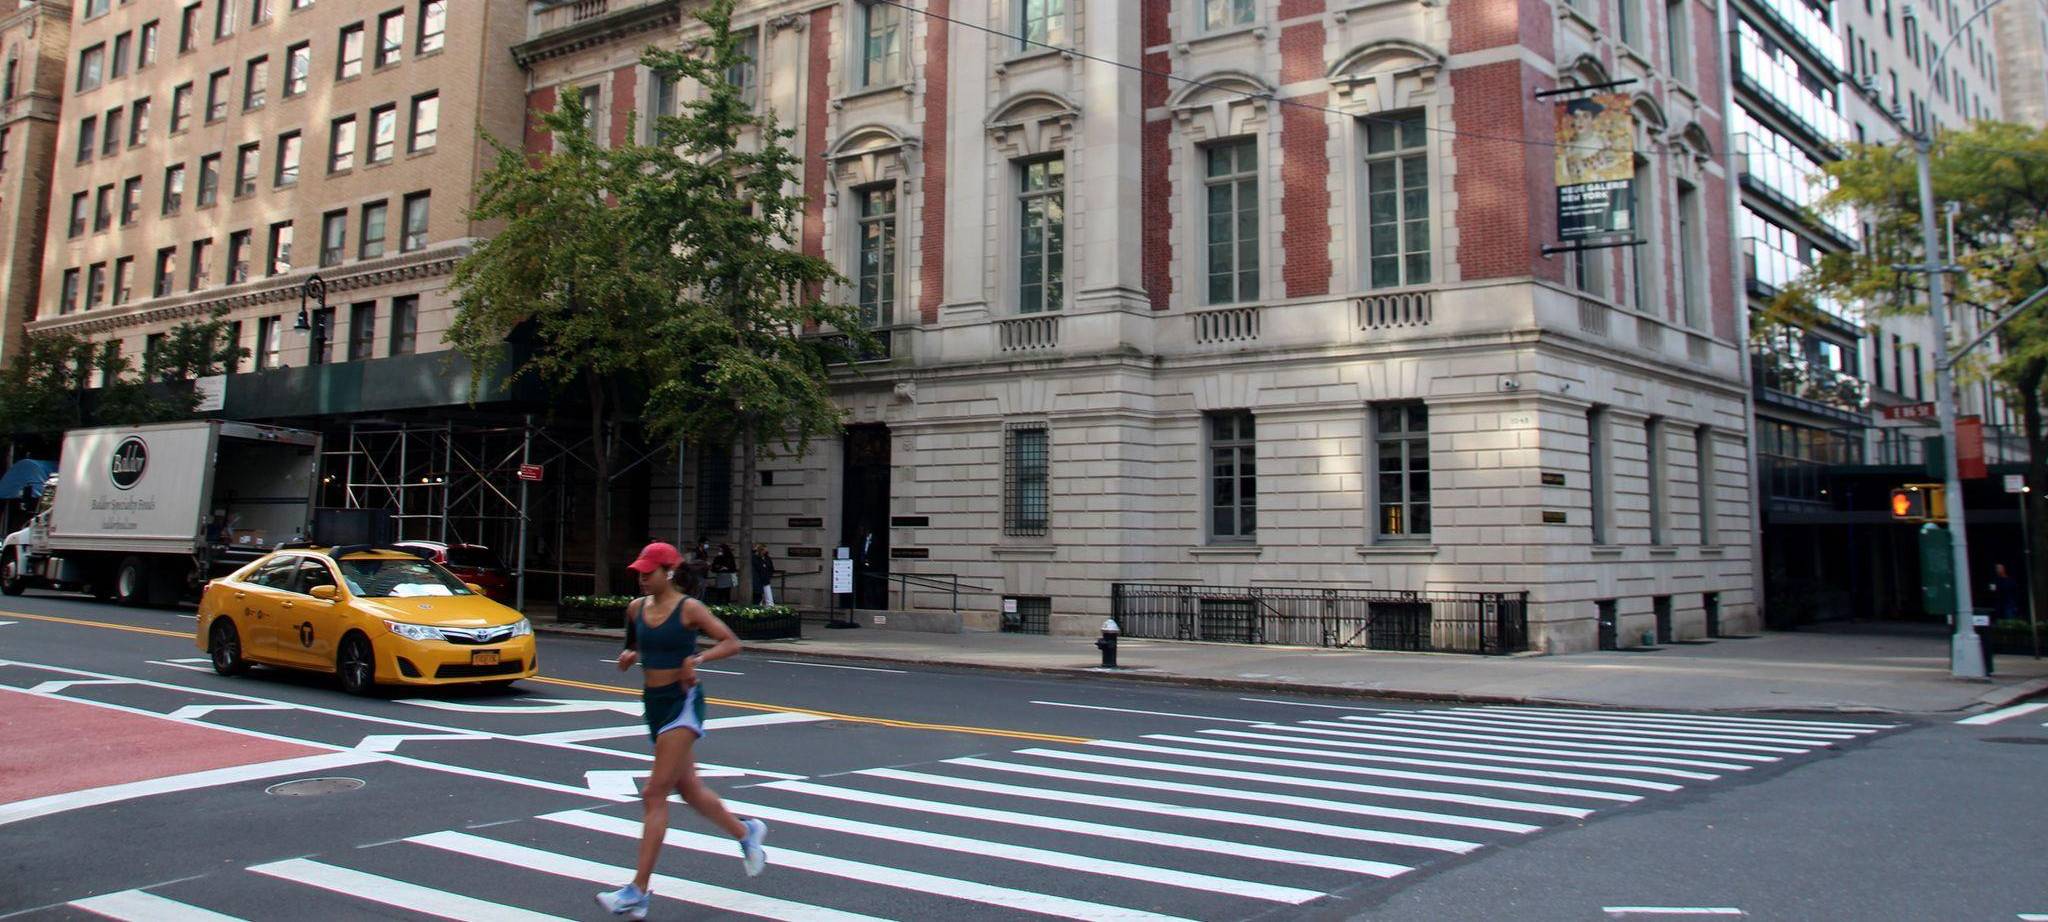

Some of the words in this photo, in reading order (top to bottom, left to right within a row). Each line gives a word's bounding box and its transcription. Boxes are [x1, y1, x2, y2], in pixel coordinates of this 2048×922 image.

[1561, 185, 1585, 195] NEUE
[1587, 181, 1629, 191] GALERIE
[1561, 194, 1580, 202] NEW
[1582, 191, 1609, 200] YORK
[303, 626, 312, 645] T
